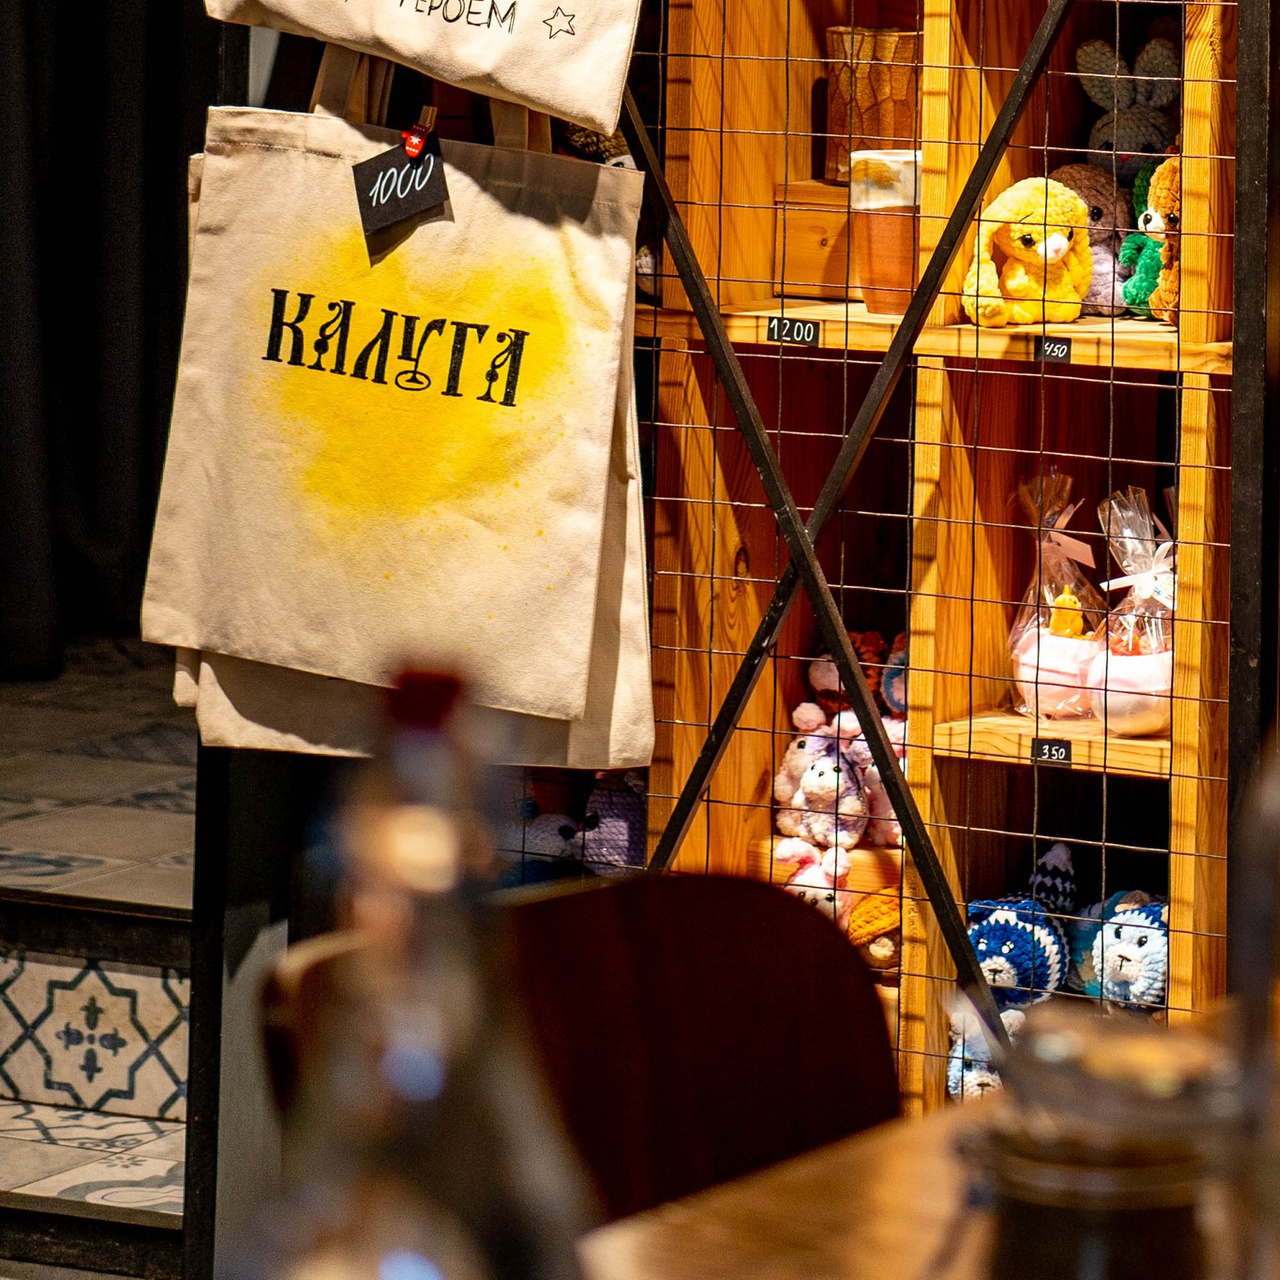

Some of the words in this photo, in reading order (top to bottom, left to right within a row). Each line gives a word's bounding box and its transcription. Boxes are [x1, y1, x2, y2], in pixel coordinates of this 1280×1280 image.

[369, 153, 435, 208] 1000
[261, 288, 531, 407] КАЛУГА
[769, 320, 814, 342] 1200
[1041, 744, 1066, 760] 350
